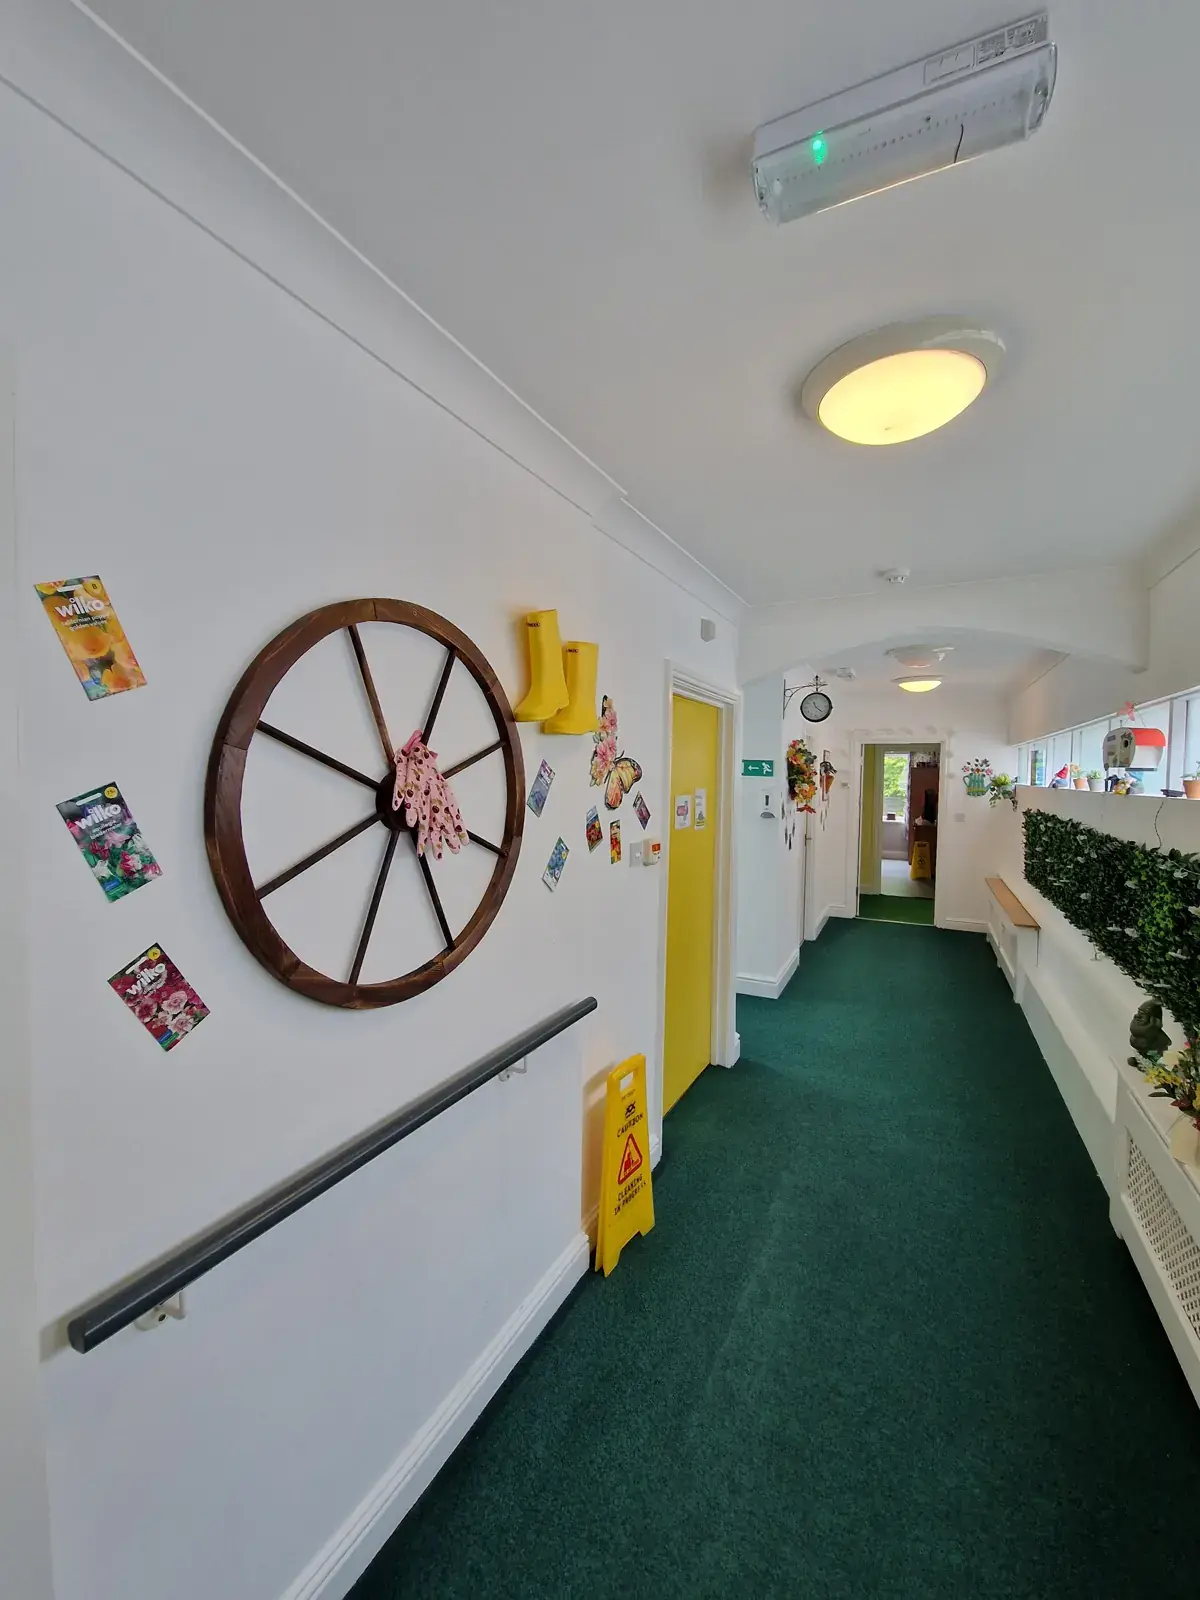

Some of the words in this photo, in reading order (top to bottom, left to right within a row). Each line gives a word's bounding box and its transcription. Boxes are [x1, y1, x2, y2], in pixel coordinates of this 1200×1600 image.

[54, 596, 104, 617] wilko
[74, 804, 121, 829] wilko
[126, 963, 166, 995] wilko
[617, 1112, 644, 1138] CAUTION
[617, 1173, 643, 1202] CLEANING
